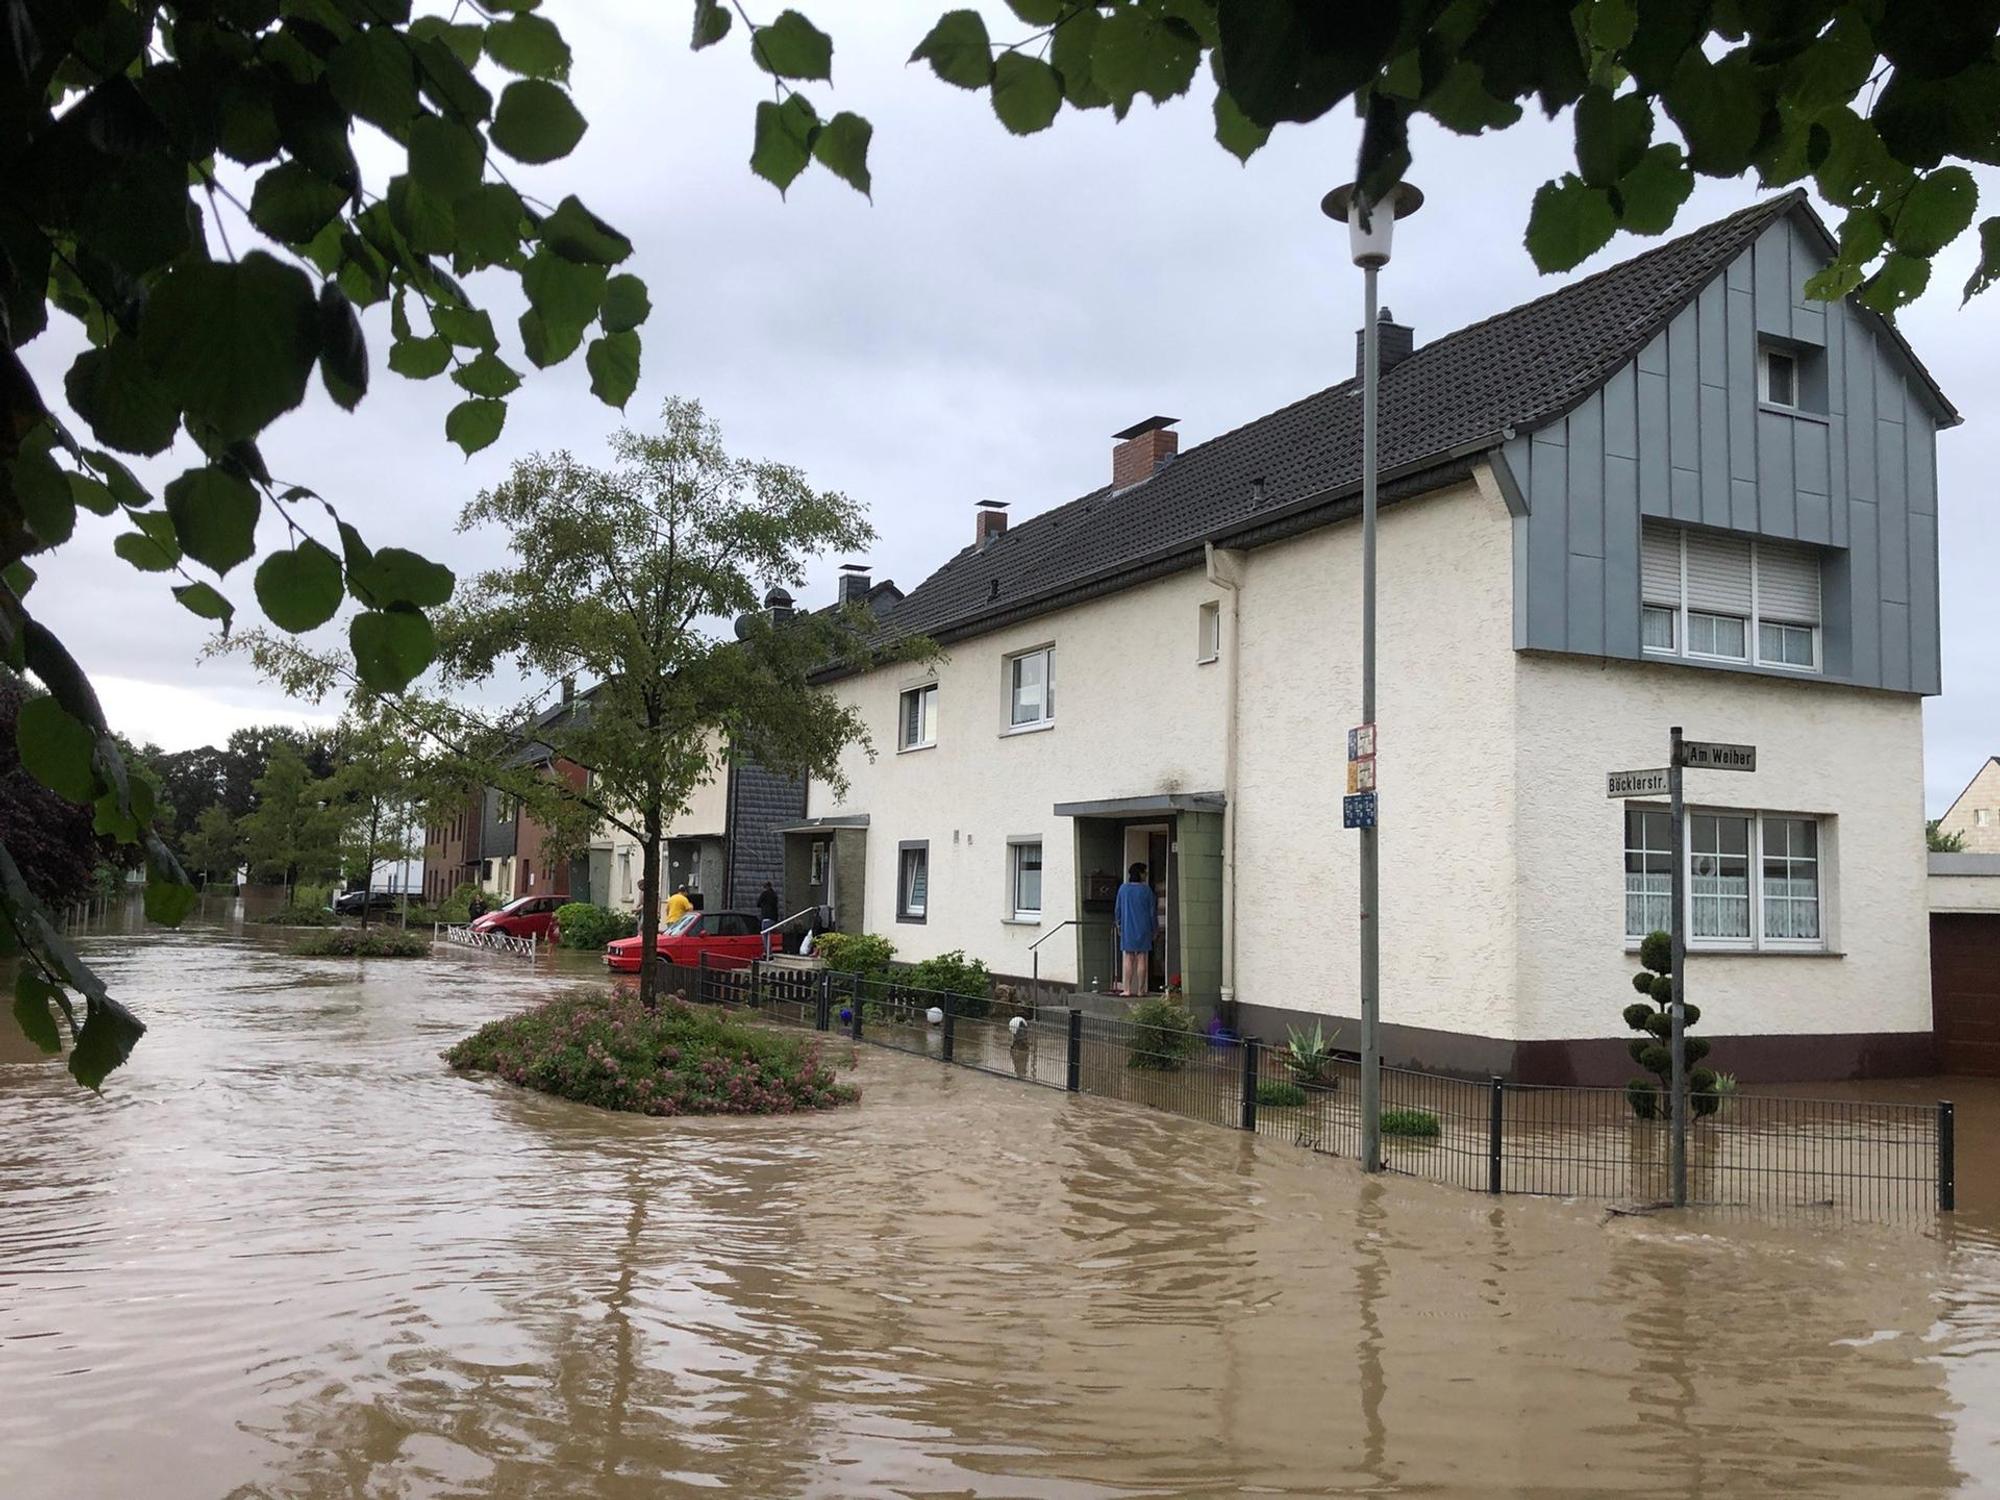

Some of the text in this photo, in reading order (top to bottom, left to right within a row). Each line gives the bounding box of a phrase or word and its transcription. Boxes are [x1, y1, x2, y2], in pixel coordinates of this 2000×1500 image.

[1690, 747, 1752, 766] Am Weiher
[1608, 775, 1667, 793] Böcklerstr.
